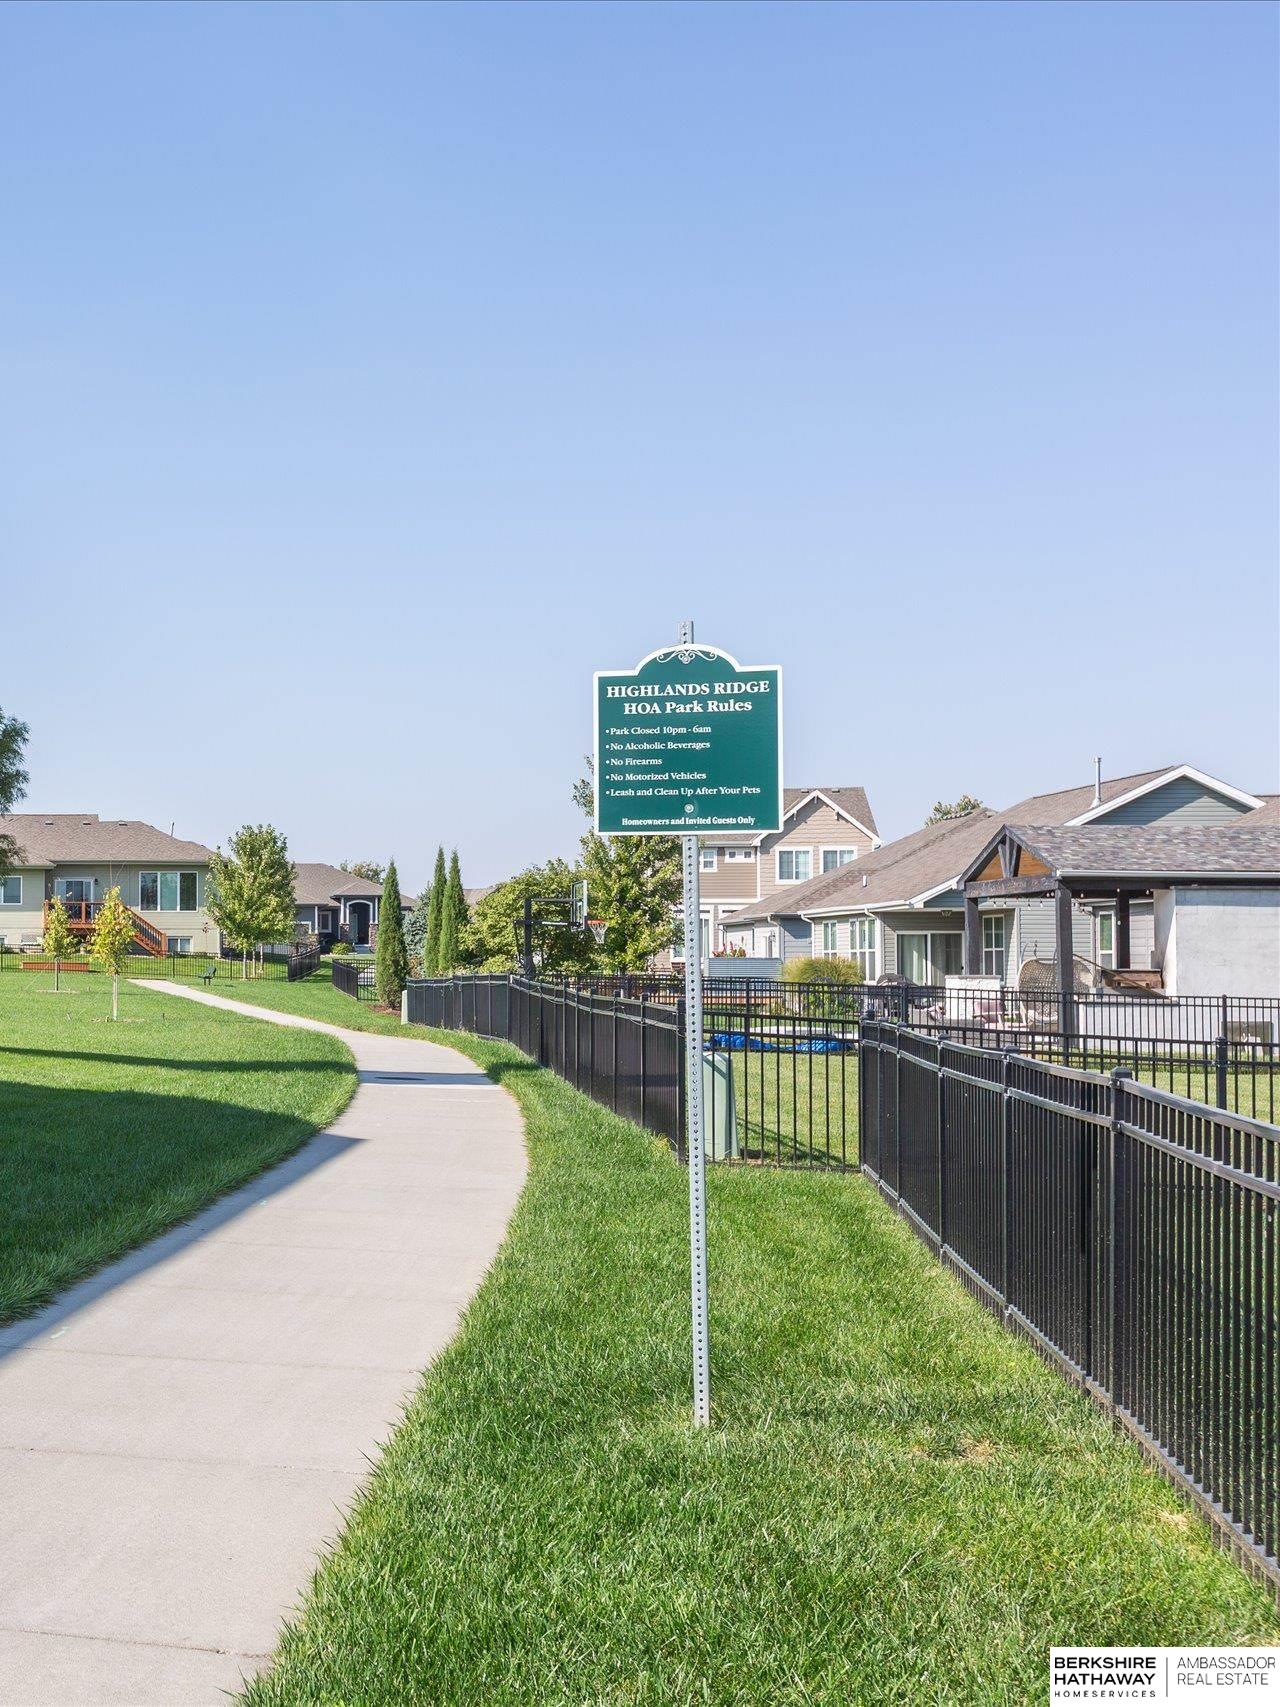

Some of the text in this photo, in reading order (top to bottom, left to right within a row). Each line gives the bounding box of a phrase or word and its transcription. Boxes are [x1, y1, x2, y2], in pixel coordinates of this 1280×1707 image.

[607, 681, 769, 697] HIGHLANDS RIDGE
[624, 699, 752, 714] HOA Park Rules
[610, 727, 629, 735] Park
[663, 727, 686, 736] 10pm
[693, 725, 711, 733] 6am
[625, 742, 665, 750] Alcoholic
[668, 742, 710, 751] Beverages
[681, 788, 694, 796] Up
[696, 787, 718, 795] After
[738, 817, 755, 825] Only
